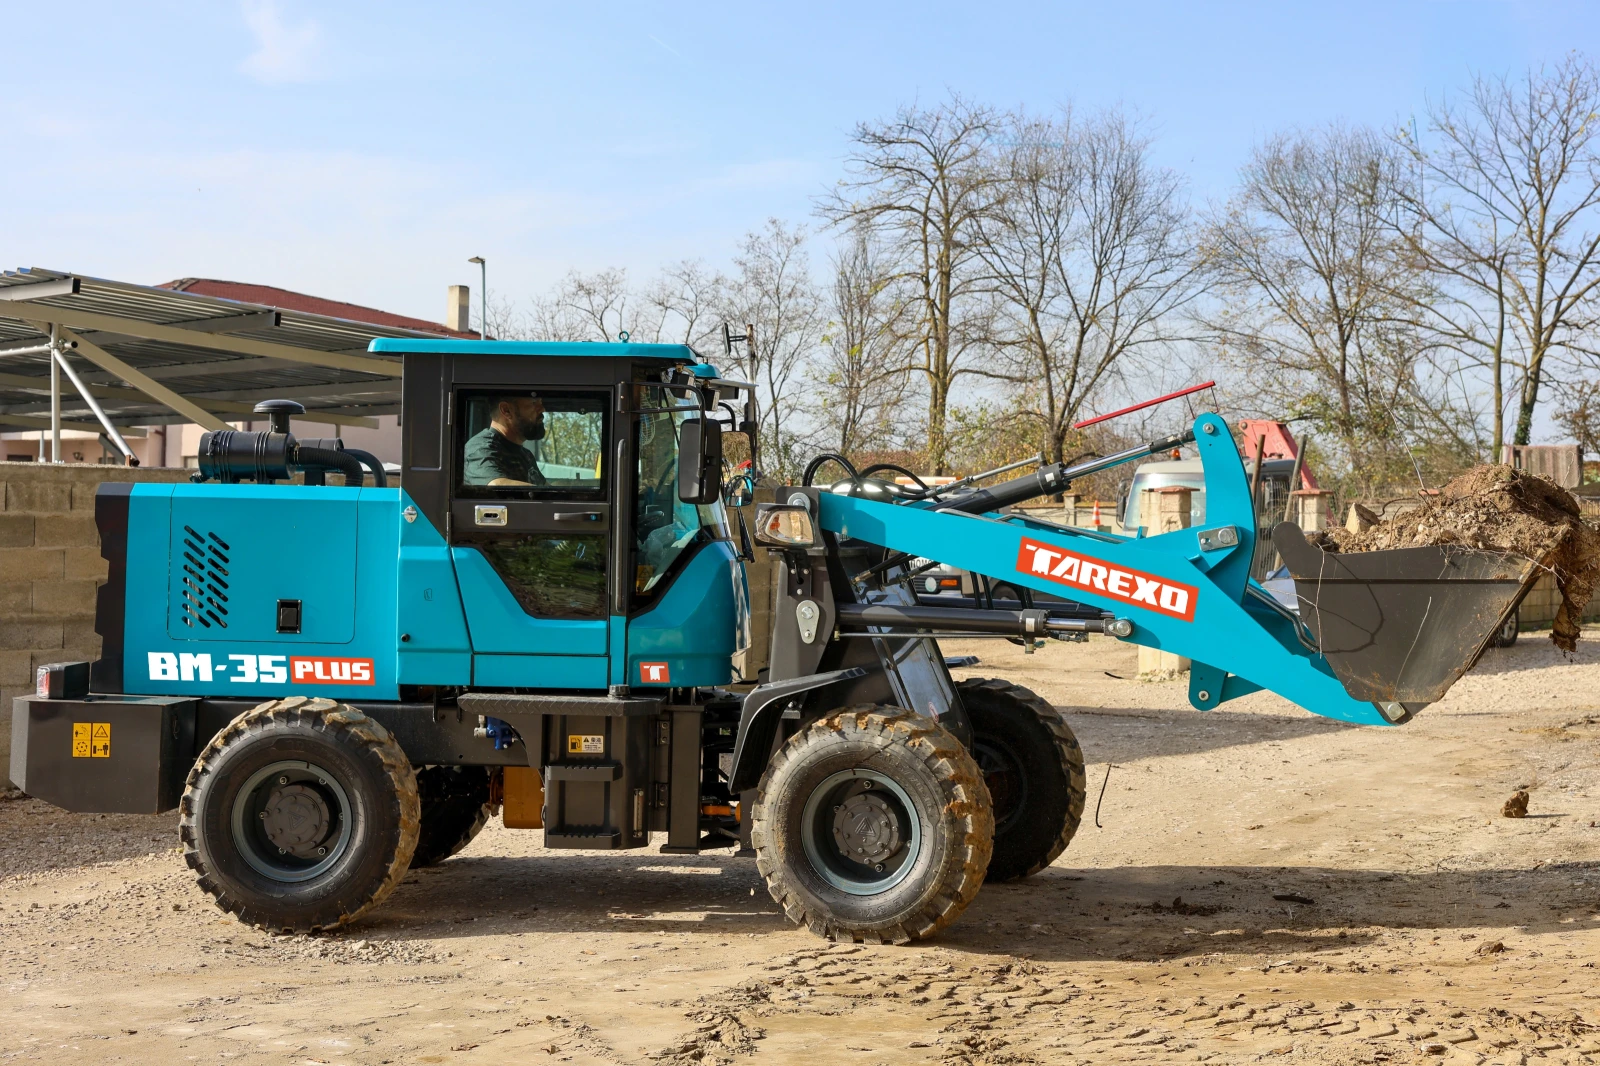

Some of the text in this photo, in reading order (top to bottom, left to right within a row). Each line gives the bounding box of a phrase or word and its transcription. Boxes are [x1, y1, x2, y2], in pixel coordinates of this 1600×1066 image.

[1025, 543, 1189, 615] TAREXO
[147, 651, 371, 684] BM-35 PLUS
